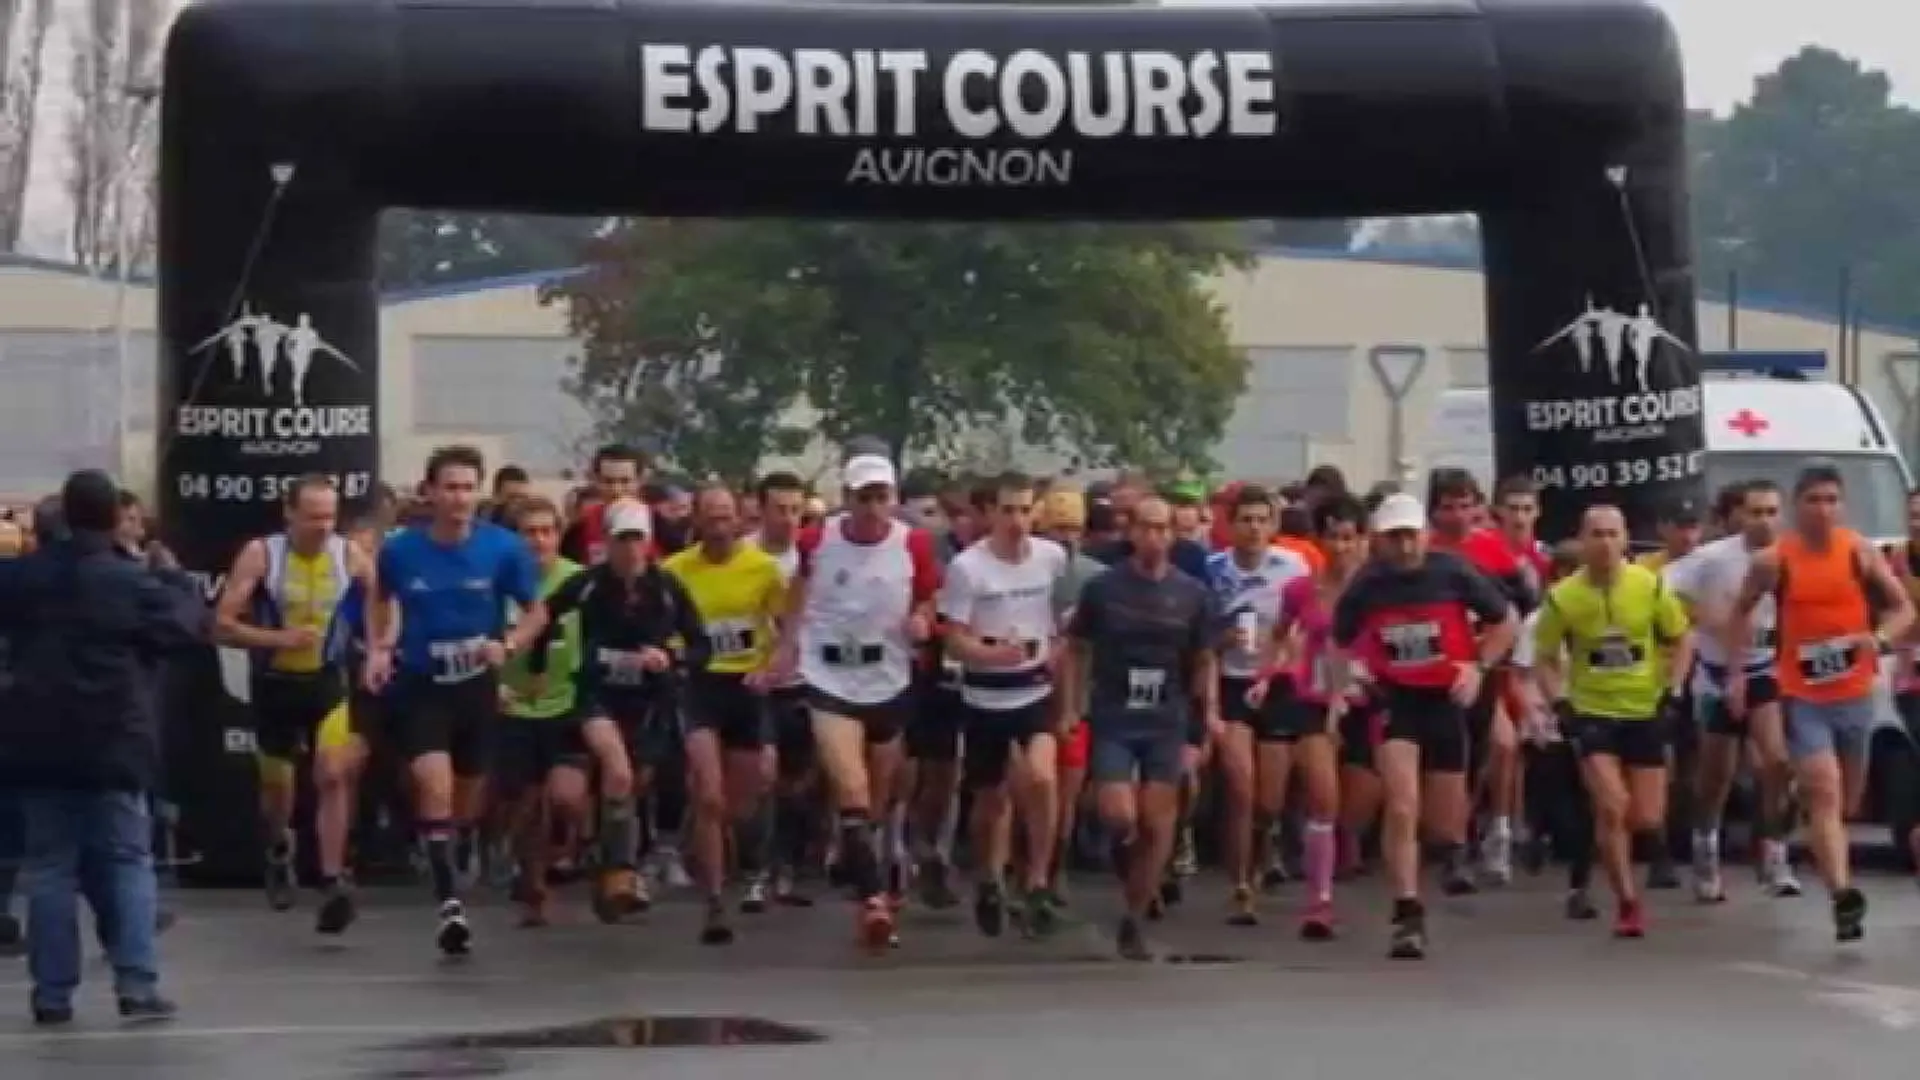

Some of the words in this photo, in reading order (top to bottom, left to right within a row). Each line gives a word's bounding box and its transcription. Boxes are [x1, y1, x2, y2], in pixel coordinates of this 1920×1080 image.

[641, 44, 927, 135] ESPRIT
[943, 48, 1276, 138] COURSE
[846, 146, 1073, 185] AVIGNON
[179, 406, 268, 436] ESPRIT
[273, 405, 370, 436] COURSE
[1527, 396, 1618, 430] ESPRIT
[179, 472, 210, 498] 04
[215, 474, 254, 500] 90
[344, 472, 370, 498] 87
[1532, 464, 1565, 487] 04
[1571, 463, 1609, 488] 90
[1614, 459, 1651, 485] 39
[1656, 455, 1683, 481] 52
